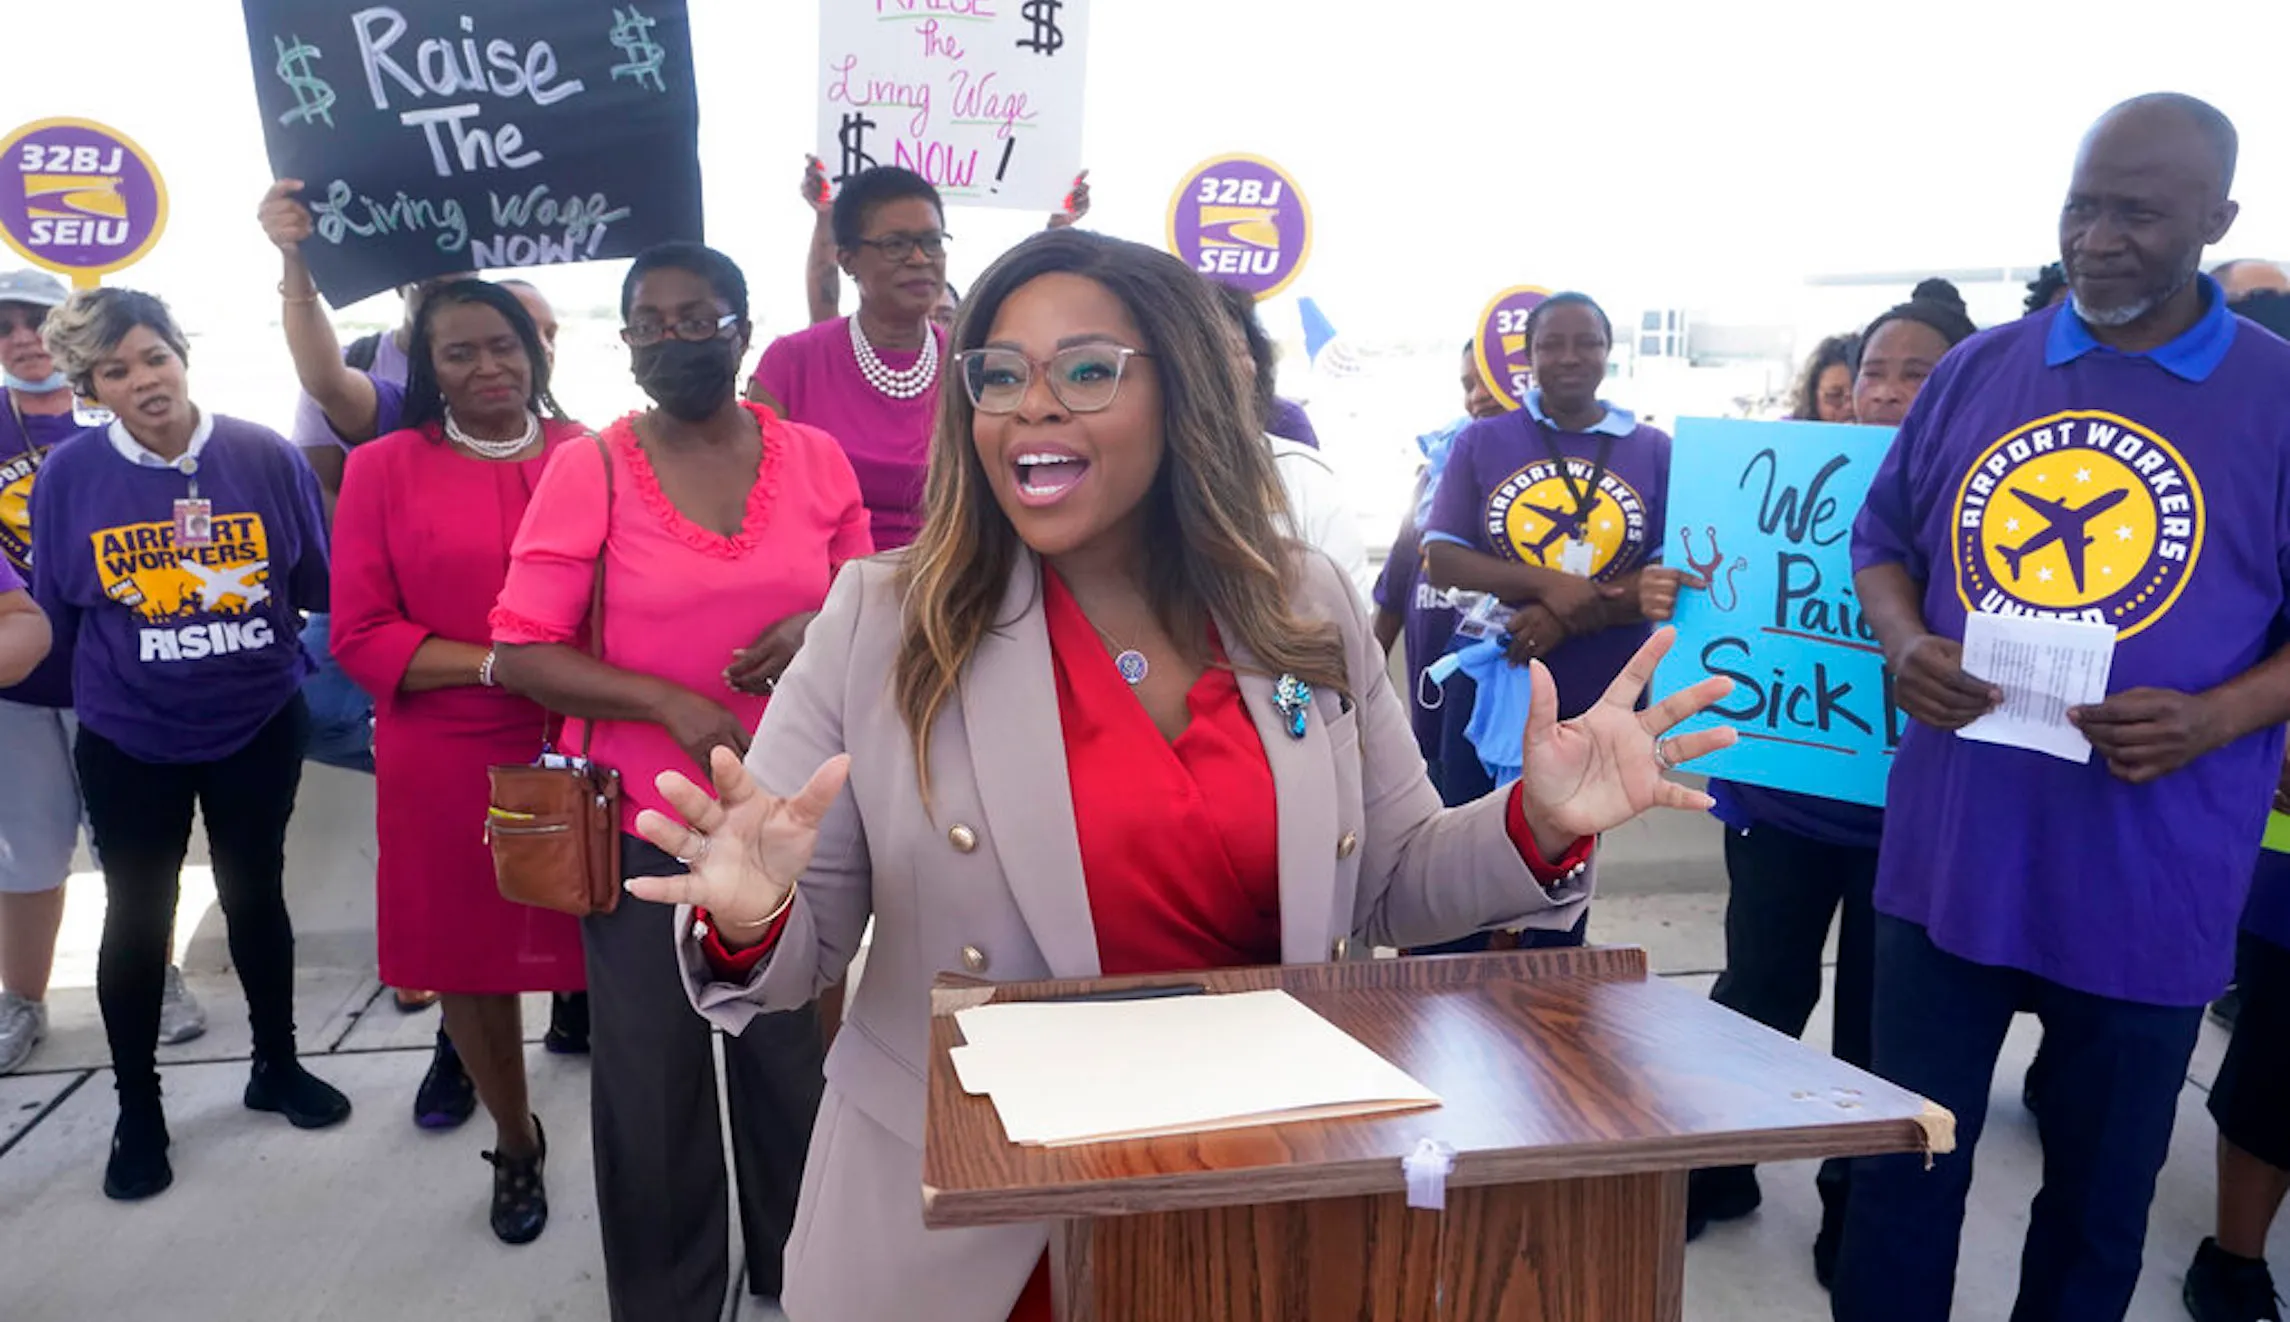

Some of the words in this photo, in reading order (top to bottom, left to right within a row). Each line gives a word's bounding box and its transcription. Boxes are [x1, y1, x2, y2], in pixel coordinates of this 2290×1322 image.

[352, 6, 585, 110] Raise
[949, 69, 1039, 140] Wage
[18, 144, 124, 175] 32BJ
[400, 104, 544, 176] The
[1197, 177, 1282, 206] 32BJ
[28, 219, 129, 246] SEIU
[311, 179, 468, 252] Living
[488, 183, 631, 240] Wage
[470, 222, 607, 269] NOW!
[1197, 249, 1281, 275] SEIU
[1497, 309, 1532, 335] 32
[1489, 462, 1558, 535] AIRPORT
[1739, 447, 1851, 546] We
[1961, 422, 2075, 528] AIRPORT
[2086, 422, 2191, 563] WORKERS
[102, 517, 253, 557] AIRPRT
[105, 542, 257, 577] WORKERS
[139, 617, 275, 662] RISING
[1701, 638, 1873, 738] Sick
